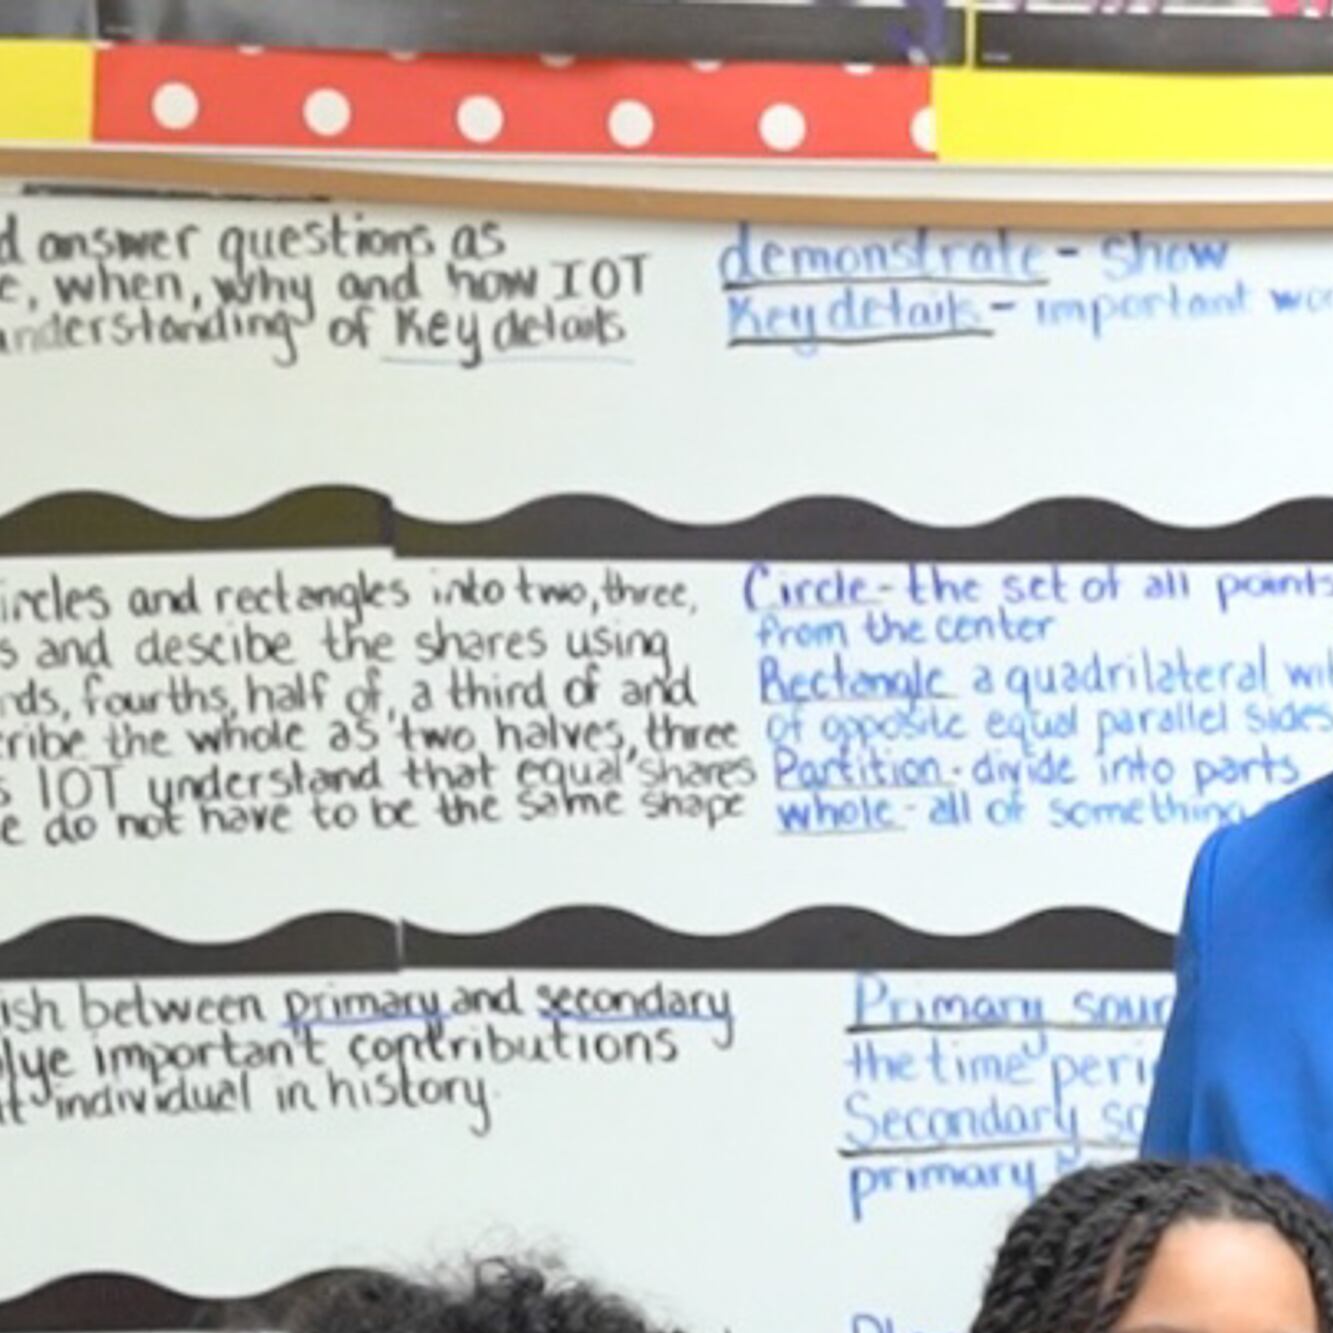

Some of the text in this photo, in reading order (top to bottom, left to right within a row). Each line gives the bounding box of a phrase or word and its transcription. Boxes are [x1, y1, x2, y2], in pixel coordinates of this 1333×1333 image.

[38, 224, 200, 262] answer
[219, 214, 435, 280] questions
[453, 220, 505, 256] as
[719, 220, 1042, 280] demonstrate
[212, 264, 315, 326] why
[337, 264, 420, 302] and
[448, 262, 537, 299] how
[556, 253, 651, 299] IOT
[728, 289, 818, 356] Key
[828, 284, 986, 333] details
[1037, 281, 1250, 338] important
[329, 308, 376, 348] of
[494, 306, 626, 348] details
[129, 574, 201, 617] and
[215, 568, 410, 624] rectangles
[432, 568, 504, 606] into
[909, 563, 980, 602] the
[1003, 564, 1068, 602] set
[1081, 564, 1120, 602] of
[1144, 569, 1190, 598] all
[36, 627, 113, 670] and
[322, 617, 397, 664] the
[415, 618, 548, 660] shares
[567, 626, 670, 680] using
[755, 606, 1056, 648] from the center
[247, 670, 330, 713] half
[411, 679, 433, 711] a
[446, 665, 547, 708] third
[563, 662, 603, 704] of
[621, 664, 698, 708] and
[759, 656, 950, 701] Rectangle
[972, 664, 995, 694] a
[1007, 642, 1269, 706] quadrilateral
[105, 721, 171, 760] the
[187, 716, 306, 752] whole
[330, 717, 380, 750] as
[398, 708, 476, 752] two
[645, 712, 740, 750] three
[766, 705, 808, 743] of
[822, 705, 966, 759] opposite
[986, 703, 1079, 758] equal
[1098, 701, 1228, 757] parallel
[38, 764, 124, 812] IOT
[149, 755, 381, 812] understand
[401, 754, 492, 790] that
[517, 755, 624, 804] equal
[636, 755, 757, 791] shares
[972, 745, 1077, 792] divide
[1100, 745, 1175, 785] into
[1193, 743, 1300, 796] parts
[45, 810, 98, 846] do
[118, 805, 185, 841] not
[201, 803, 292, 834] have
[312, 793, 358, 828] to
[371, 791, 421, 828] be
[437, 788, 504, 825] the
[520, 789, 626, 820] same
[640, 787, 747, 830] shape
[930, 789, 972, 827] all
[986, 789, 1025, 826] of
[80, 979, 266, 1030] between
[284, 984, 445, 1040] primary
[452, 979, 522, 1017] and
[537, 979, 735, 1048] secondary
[852, 972, 1047, 1054] Primary
[95, 1028, 327, 1088] important
[350, 1024, 680, 1067] contributions
[845, 1038, 916, 1082] the
[927, 1035, 1035, 1084] time
[277, 1077, 317, 1113] in
[845, 1090, 1081, 1167] Secondary
